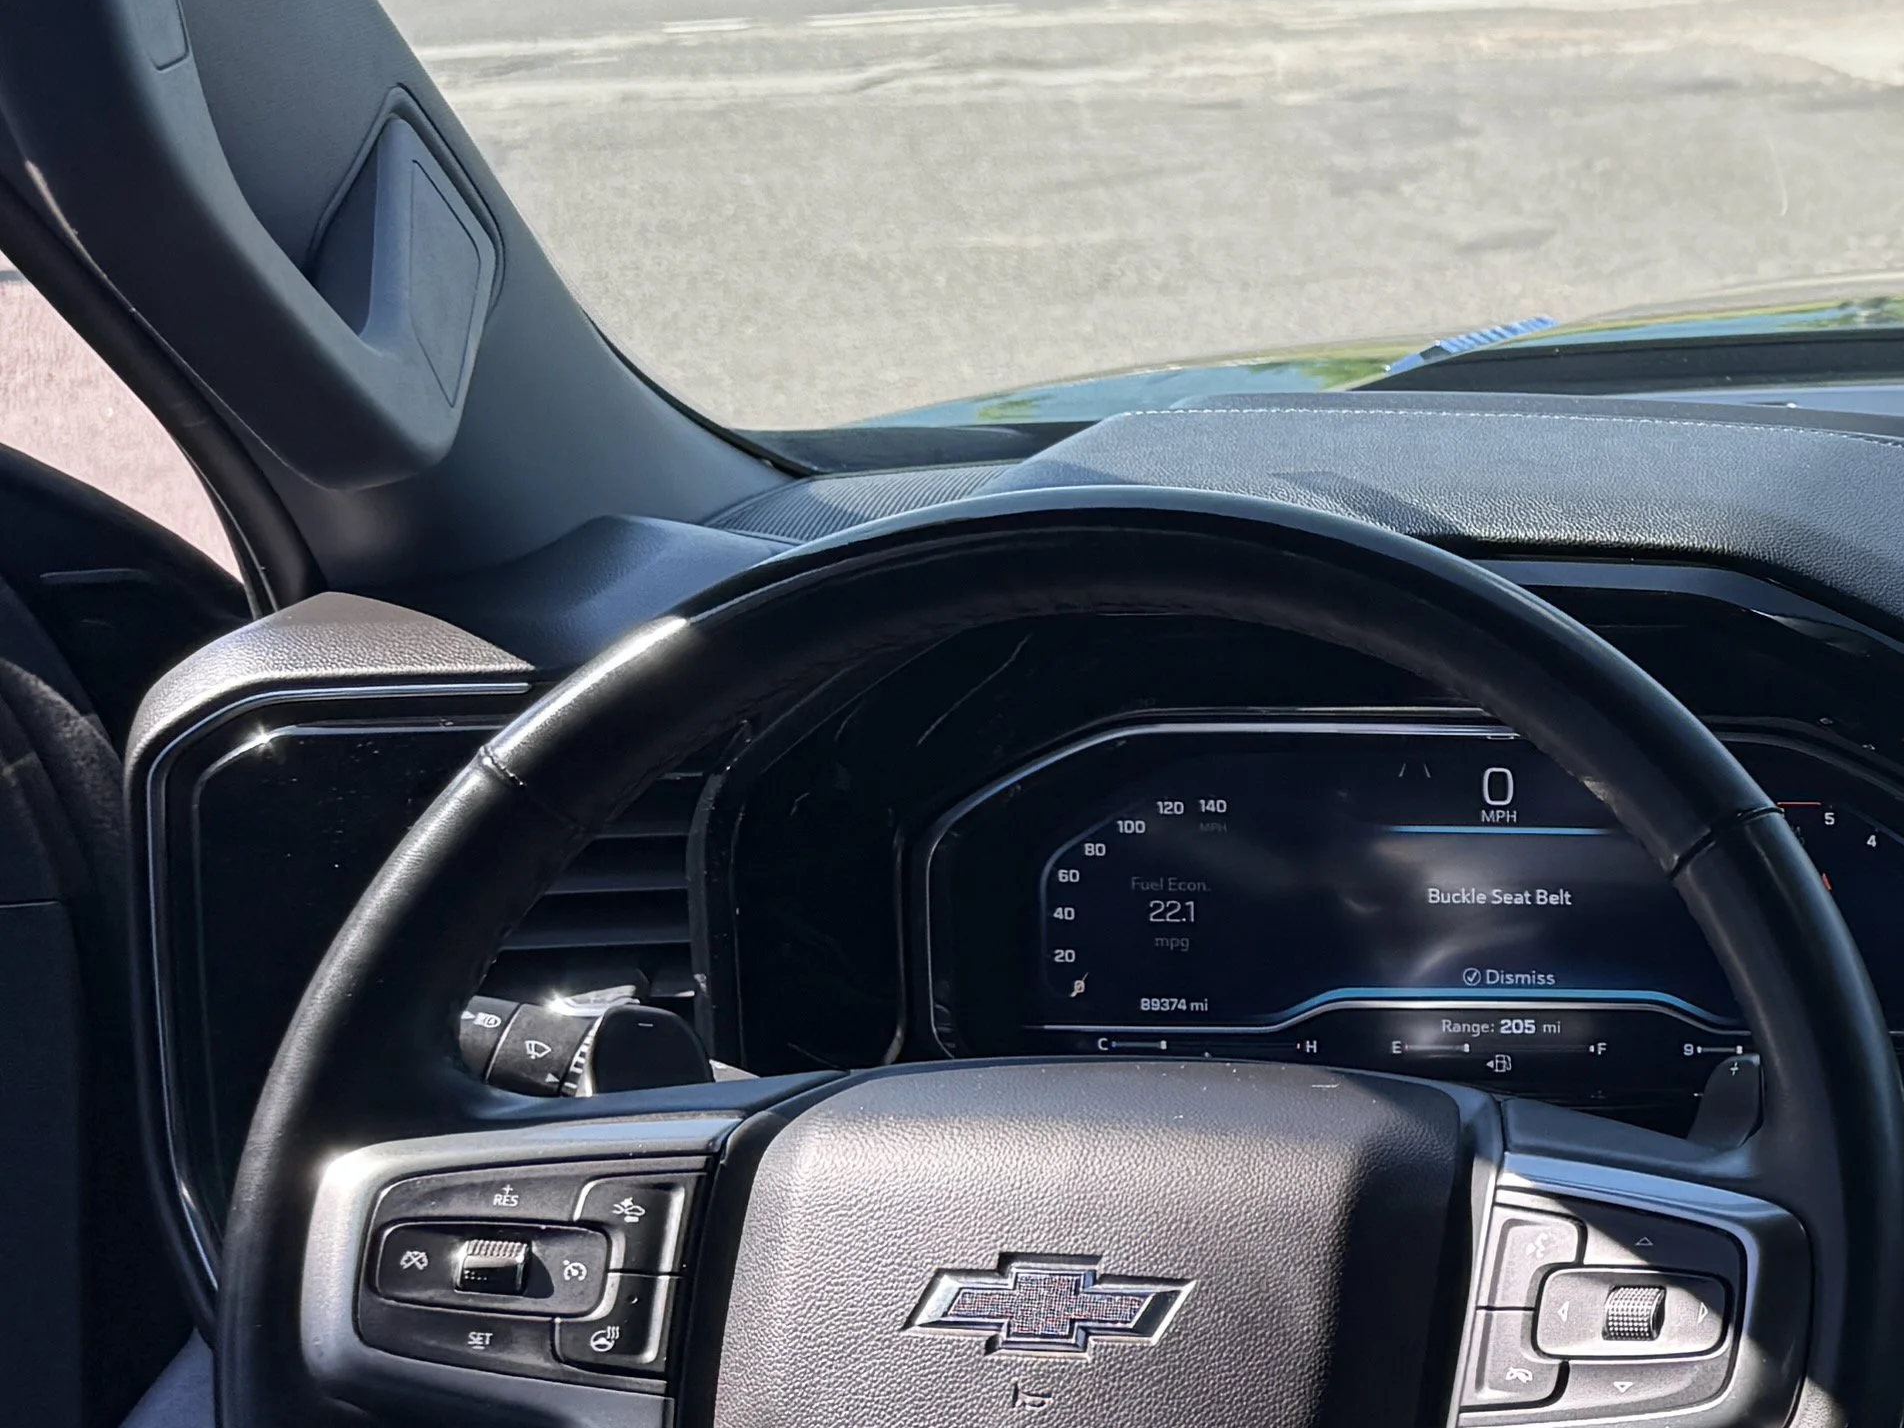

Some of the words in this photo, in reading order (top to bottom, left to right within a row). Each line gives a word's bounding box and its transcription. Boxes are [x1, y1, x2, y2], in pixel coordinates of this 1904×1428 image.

[1482, 767, 1515, 807] 0
[1156, 801, 1185, 815] 120
[1199, 799, 1228, 814] 140
[1480, 810, 1518, 824] MPH
[1823, 812, 1836, 826] 5
[1117, 820, 1147, 834] 100
[1865, 834, 1879, 849] 4
[1084, 842, 1107, 857] 80
[1057, 868, 1080, 883] 60
[1131, 876, 1164, 891] Fuel
[1167, 879, 1212, 893] Econ.
[1427, 888, 1488, 905] Buckle
[1490, 889, 1532, 906] Seat
[1535, 891, 1574, 907] Belt
[1052, 907, 1076, 921] 40
[1148, 899, 1196, 923] 22.1
[1153, 936, 1191, 953] mpg
[1053, 949, 1076, 963] 20
[1485, 969, 1556, 987] Dismiss
[1140, 997, 1187, 1012] 89374
[1190, 998, 1208, 1012] mi
[1441, 1018, 1496, 1037] Range:
[1499, 1019, 1537, 1035] 205
[1542, 1020, 1562, 1035] mi
[1097, 1037, 1109, 1052] C
[1305, 1040, 1318, 1054] H
[1391, 1041, 1402, 1054] E
[1597, 1042, 1608, 1055] F
[492, 1194, 520, 1209] RES
[467, 1332, 494, 1346] SET
